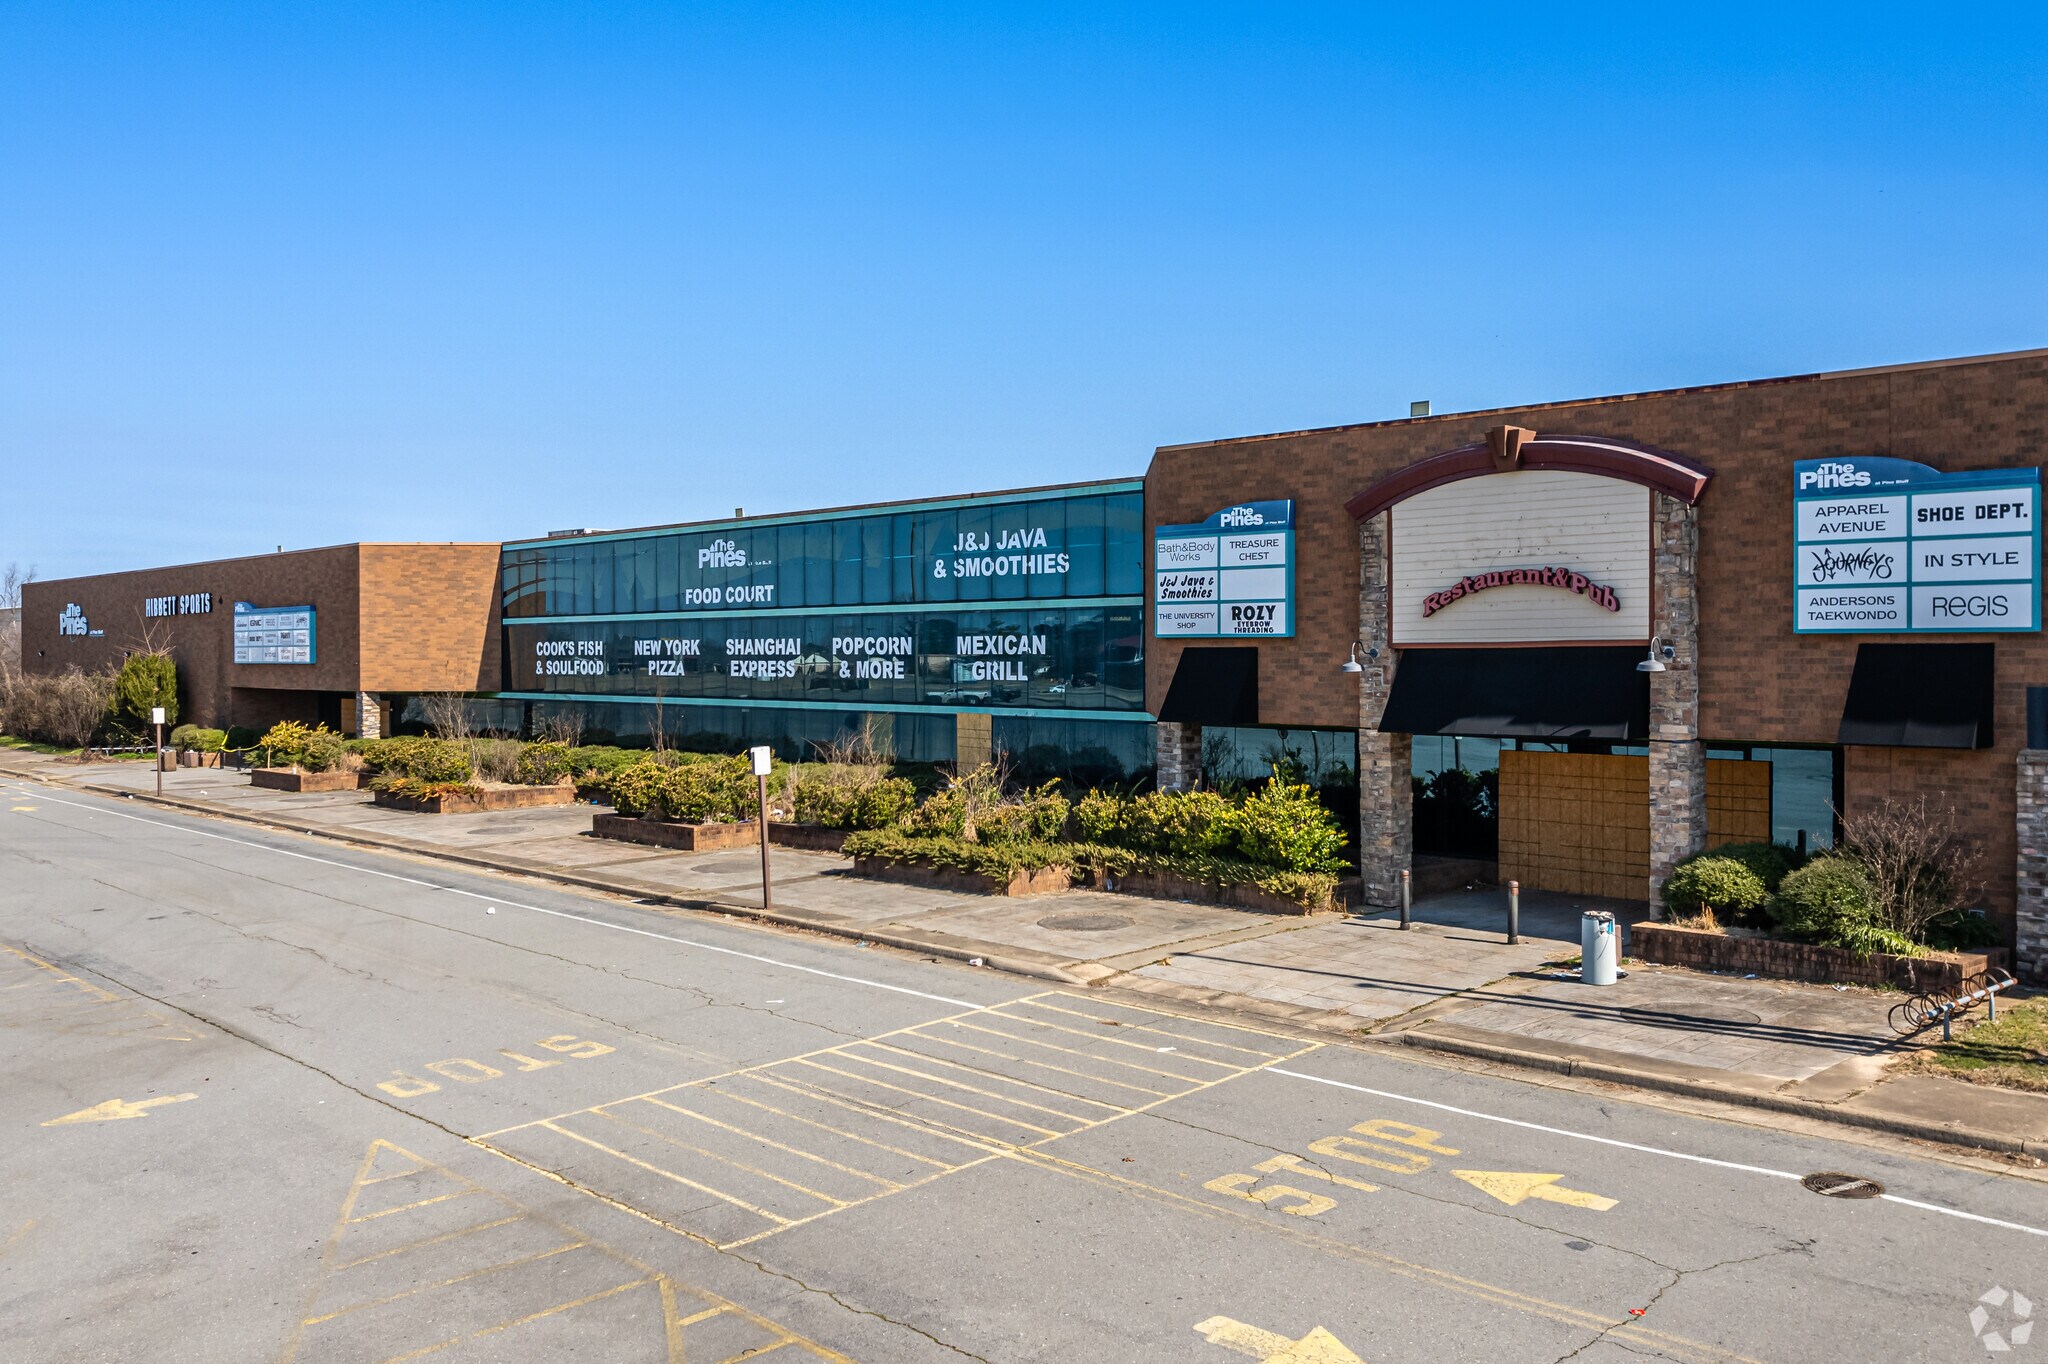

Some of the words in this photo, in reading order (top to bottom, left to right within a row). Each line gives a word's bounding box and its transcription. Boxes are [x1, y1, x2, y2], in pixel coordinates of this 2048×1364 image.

[1822, 463, 1855, 475] The
[1800, 469, 1871, 490] Pines
[1233, 506, 1254, 516] The
[1815, 503, 1890, 518] APPAREL
[1917, 506, 1965, 523] SHOE
[1975, 502, 2029, 520] DEPT.
[1220, 512, 1264, 528] Pines
[1818, 520, 1887, 534] AVENUE
[714, 538, 736, 552] The
[953, 531, 990, 552] J&J
[996, 527, 1048, 550] JAVA
[1158, 541, 1215, 554] Bath&Body
[1229, 538, 1280, 550] TREASURE
[698, 548, 747, 569] Pines
[1170, 552, 1201, 562] Works
[1238, 551, 1270, 561] CHEST
[1924, 554, 1944, 568] IN
[1951, 552, 2020, 567] STYLE
[933, 559, 948, 579] &
[953, 552, 1070, 578] SMOOTHIES
[1811, 546, 1895, 583] JOURNEYS
[1160, 575, 1178, 587] J&J
[1181, 575, 1205, 587] Java
[1208, 577, 1215, 585] &
[685, 587, 722, 605] FOOD
[725, 584, 775, 604] COURT
[1161, 587, 1213, 600] Smoothies
[1809, 595, 1896, 607] ANDERSONS
[66, 603, 82, 617] The
[145, 595, 178, 618] HIBBETT
[180, 592, 212, 615] SPORTS
[1231, 605, 1276, 621] ROZY
[59, 612, 88, 635] Pines
[249, 619, 262, 627] GNC
[1159, 612, 1173, 620] THE
[1173, 612, 1215, 620] UNIVERSITY
[1807, 610, 1898, 621] TAEKWONDO
[536, 641, 575, 656] COOK'S
[577, 640, 603, 655] FISH
[634, 640, 662, 656] NEW
[664, 639, 700, 656] YORK
[726, 638, 801, 656] SHANGHAI
[832, 636, 913, 656] POPCORN
[956, 635, 1047, 656] MEXICAN
[536, 660, 544, 675] &
[546, 660, 604, 675] SOULFOOD
[648, 660, 685, 676] PIZZA
[730, 660, 796, 678] EXPRESS
[838, 660, 851, 679] &
[856, 661, 905, 680] MORE
[971, 660, 1029, 681] GRILL
[376, 1034, 618, 1099] STOP
[1201, 1118, 1463, 1217] STOP
